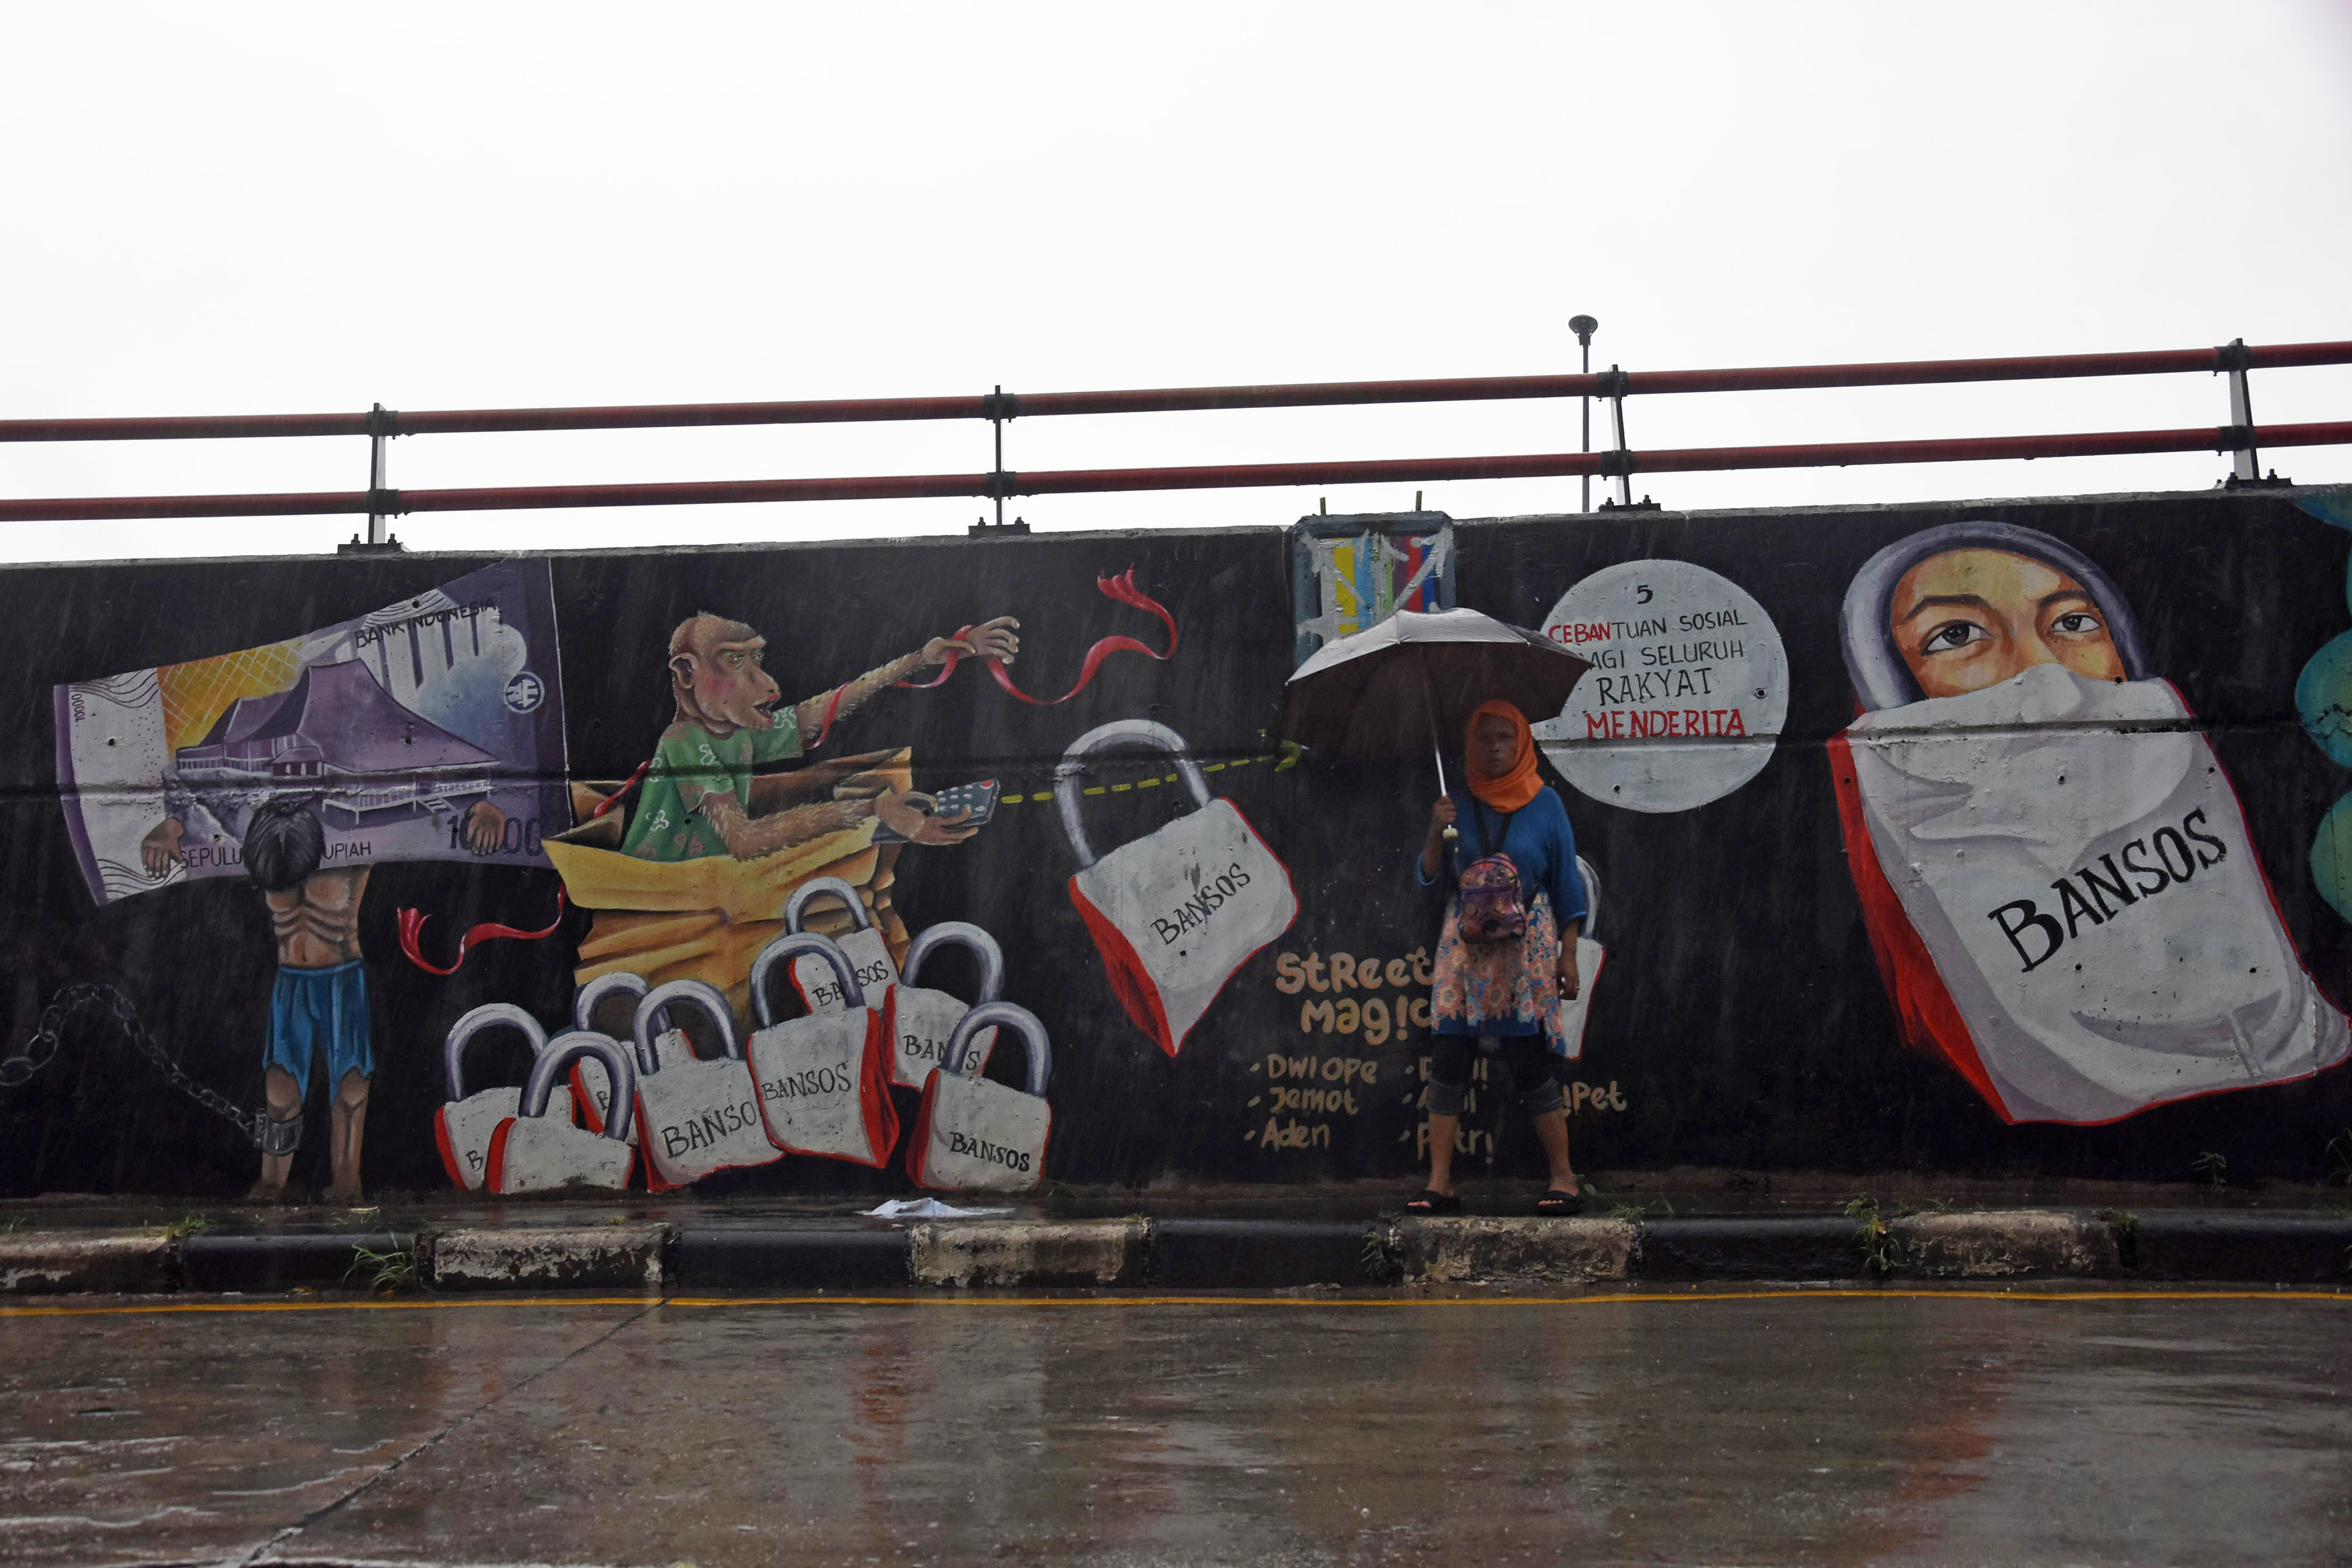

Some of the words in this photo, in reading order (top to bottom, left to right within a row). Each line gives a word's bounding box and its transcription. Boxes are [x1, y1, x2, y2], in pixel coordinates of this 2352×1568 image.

[1637, 585, 1653, 604] 5
[355, 624, 405, 648] BANK
[407, 596, 496, 628] INDONESIA
[1548, 617, 1667, 643] CEBANTUAN
[1679, 609, 1748, 631] SOSIAL
[1579, 650, 1625, 670] AGI
[1640, 641, 1745, 666] SELURUH
[1596, 667, 1712, 706] RAKYAT
[71, 693, 85, 722] 10000
[1585, 708, 1747, 739] MENDERITA
[181, 847, 243, 869] SEPULU
[323, 842, 372, 860] UPIAH
[1151, 863, 1251, 946] BANSOS
[1987, 807, 2227, 973] BANSOS
[812, 960, 889, 1006] BASOS
[761, 1061, 851, 1101] BANSOS
[661, 1101, 757, 1159] BANSO
[949, 1132, 1030, 1172] BANSOS
